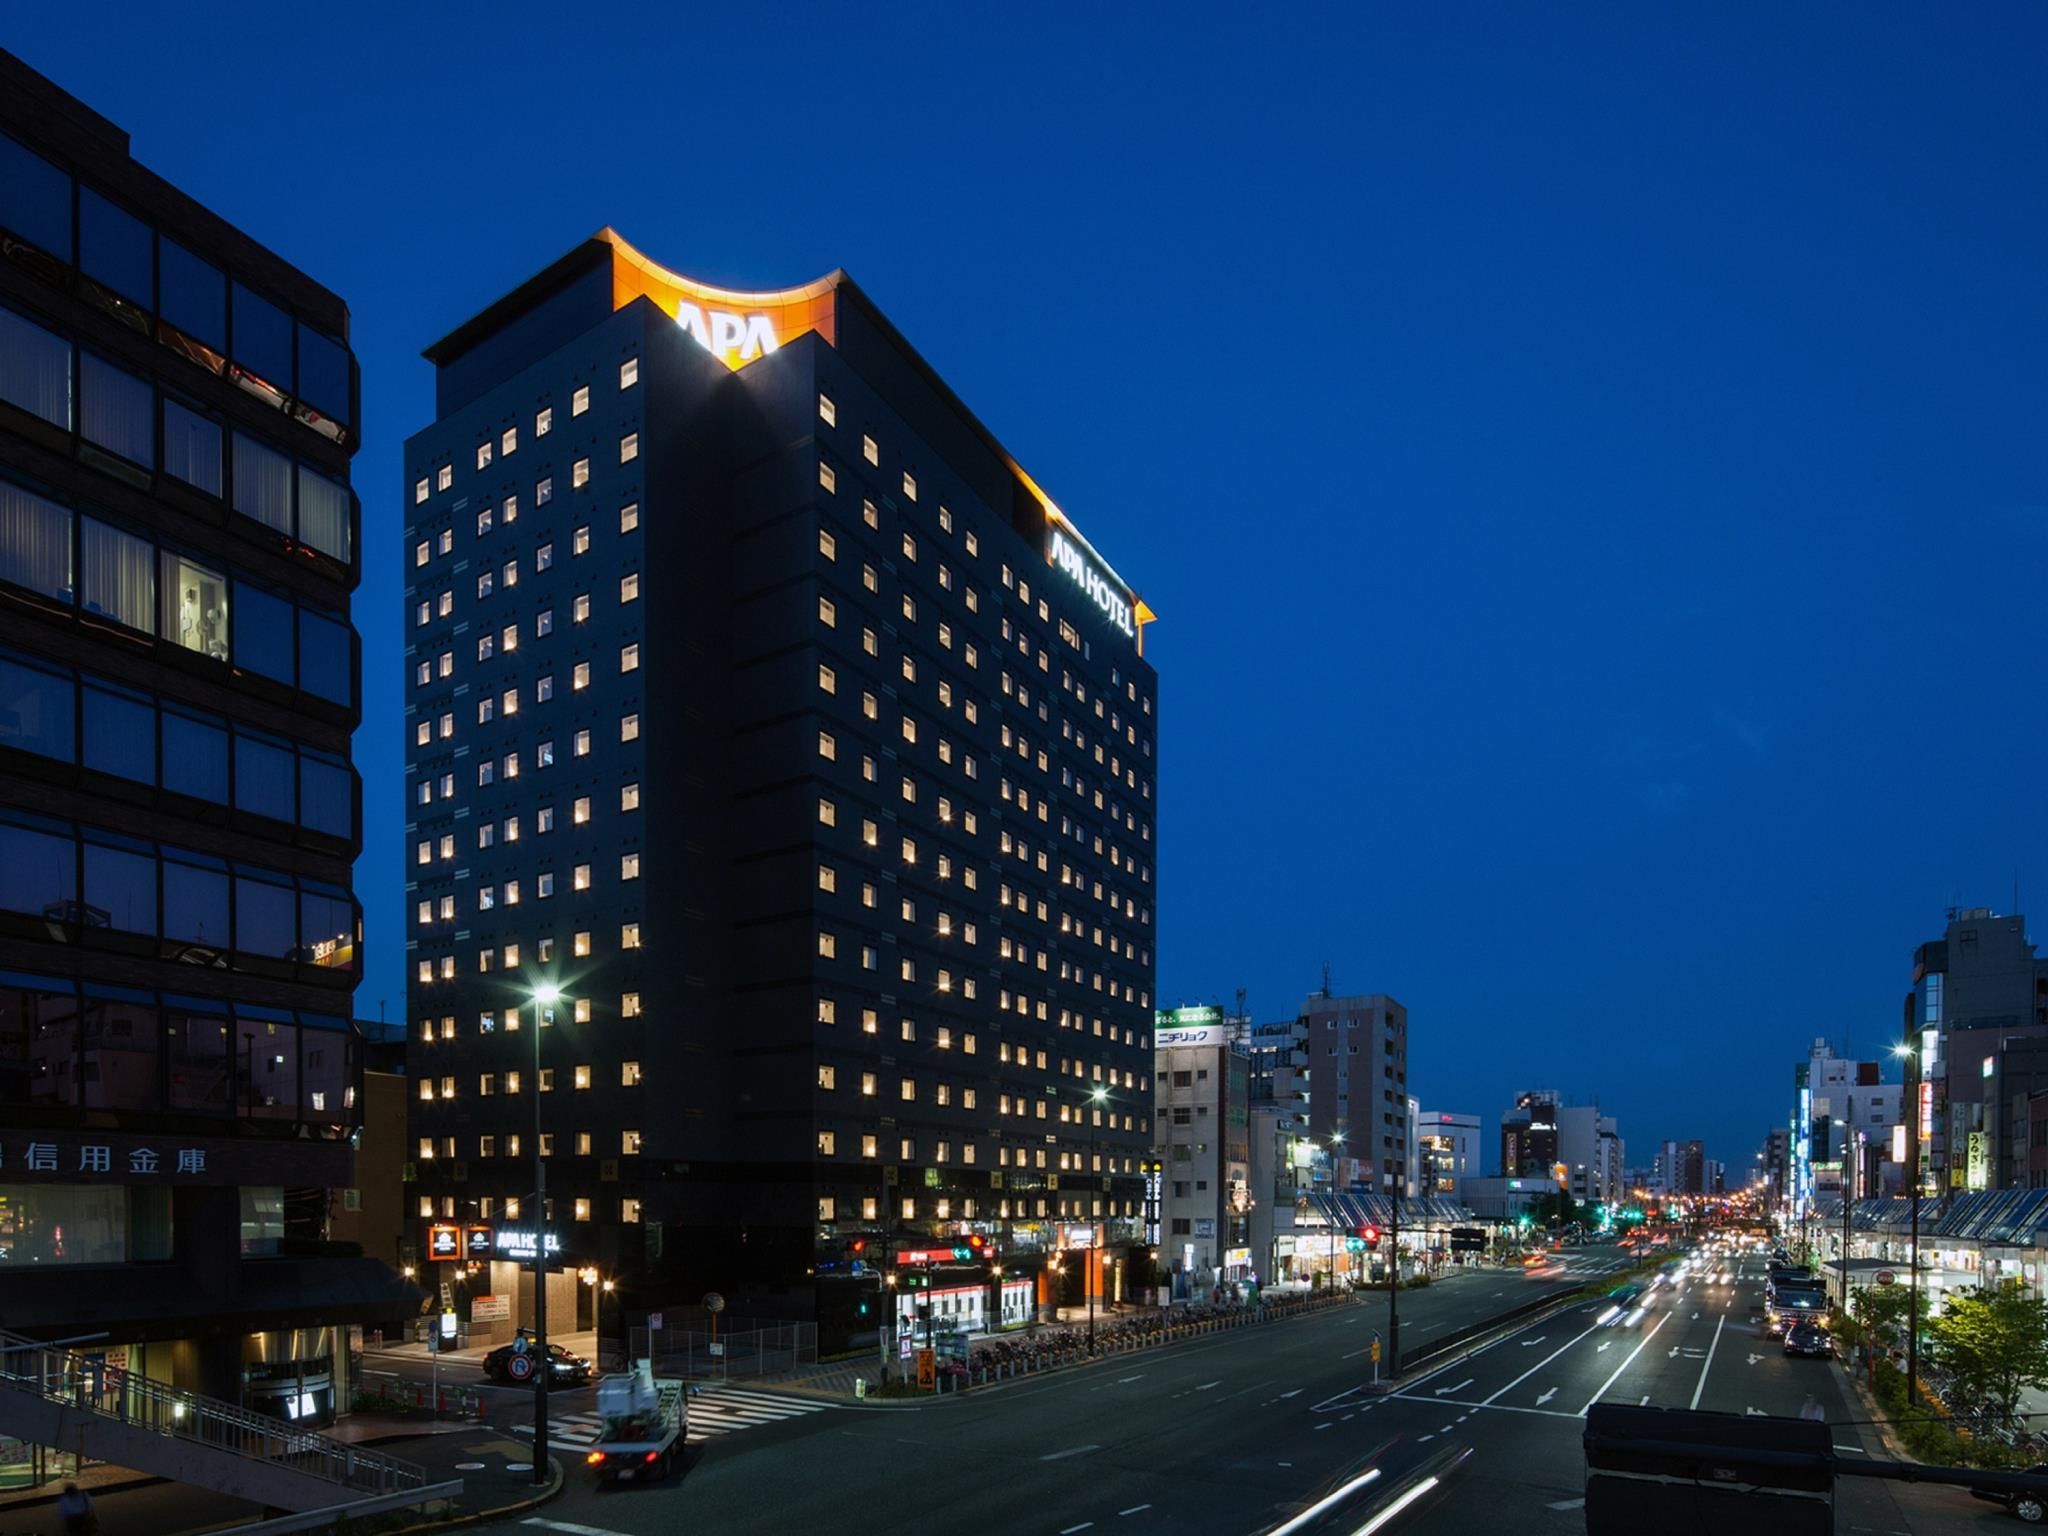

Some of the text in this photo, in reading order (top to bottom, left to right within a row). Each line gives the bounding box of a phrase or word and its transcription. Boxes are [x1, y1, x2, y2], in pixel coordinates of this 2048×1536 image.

[674, 301, 779, 360] APA
[1051, 531, 1134, 638] APA HOTEL
[1158, 1031, 1208, 1044] ニチリョク
[0, 1142, 207, 1175] 信用金庫
[496, 1231, 521, 1249] APA
[521, 1232, 560, 1251] HOEL
